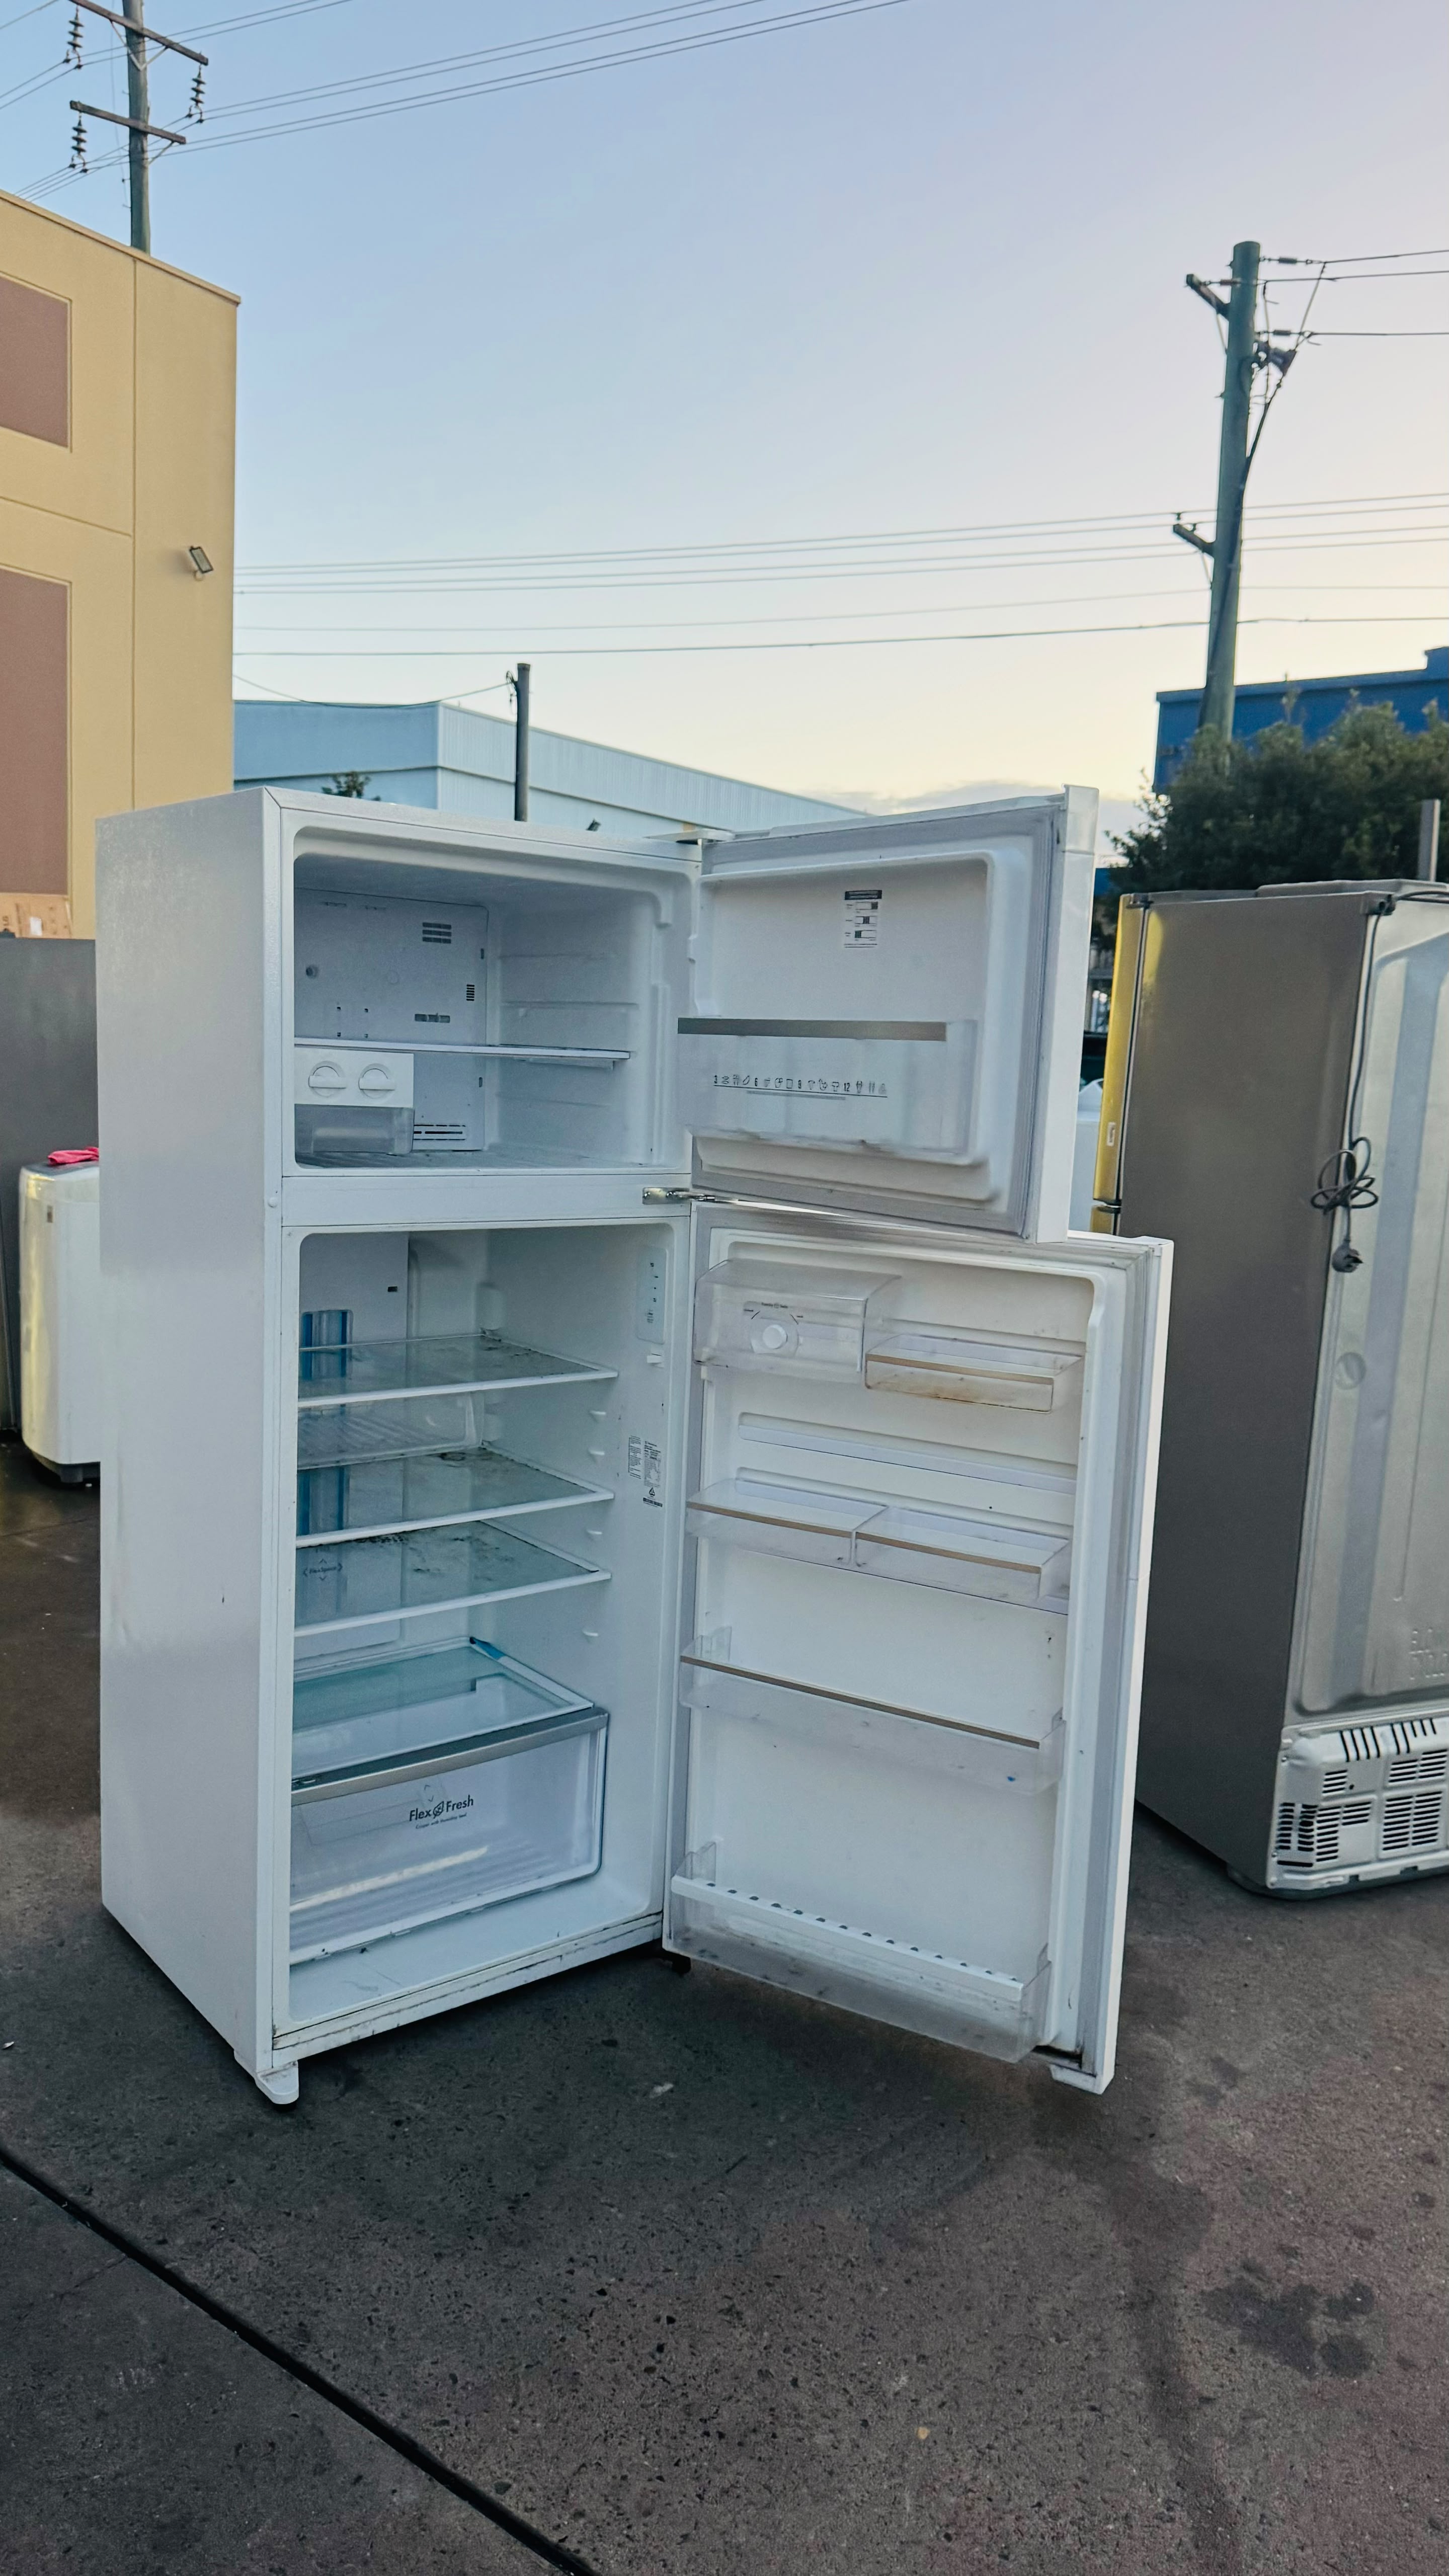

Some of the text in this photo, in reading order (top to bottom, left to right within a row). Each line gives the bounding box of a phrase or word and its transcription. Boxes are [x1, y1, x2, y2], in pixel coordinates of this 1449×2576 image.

[755, 1077, 758, 1087] 6
[844, 1082, 850, 1092] 12
[409, 1794, 473, 1822] Flex Fresh
